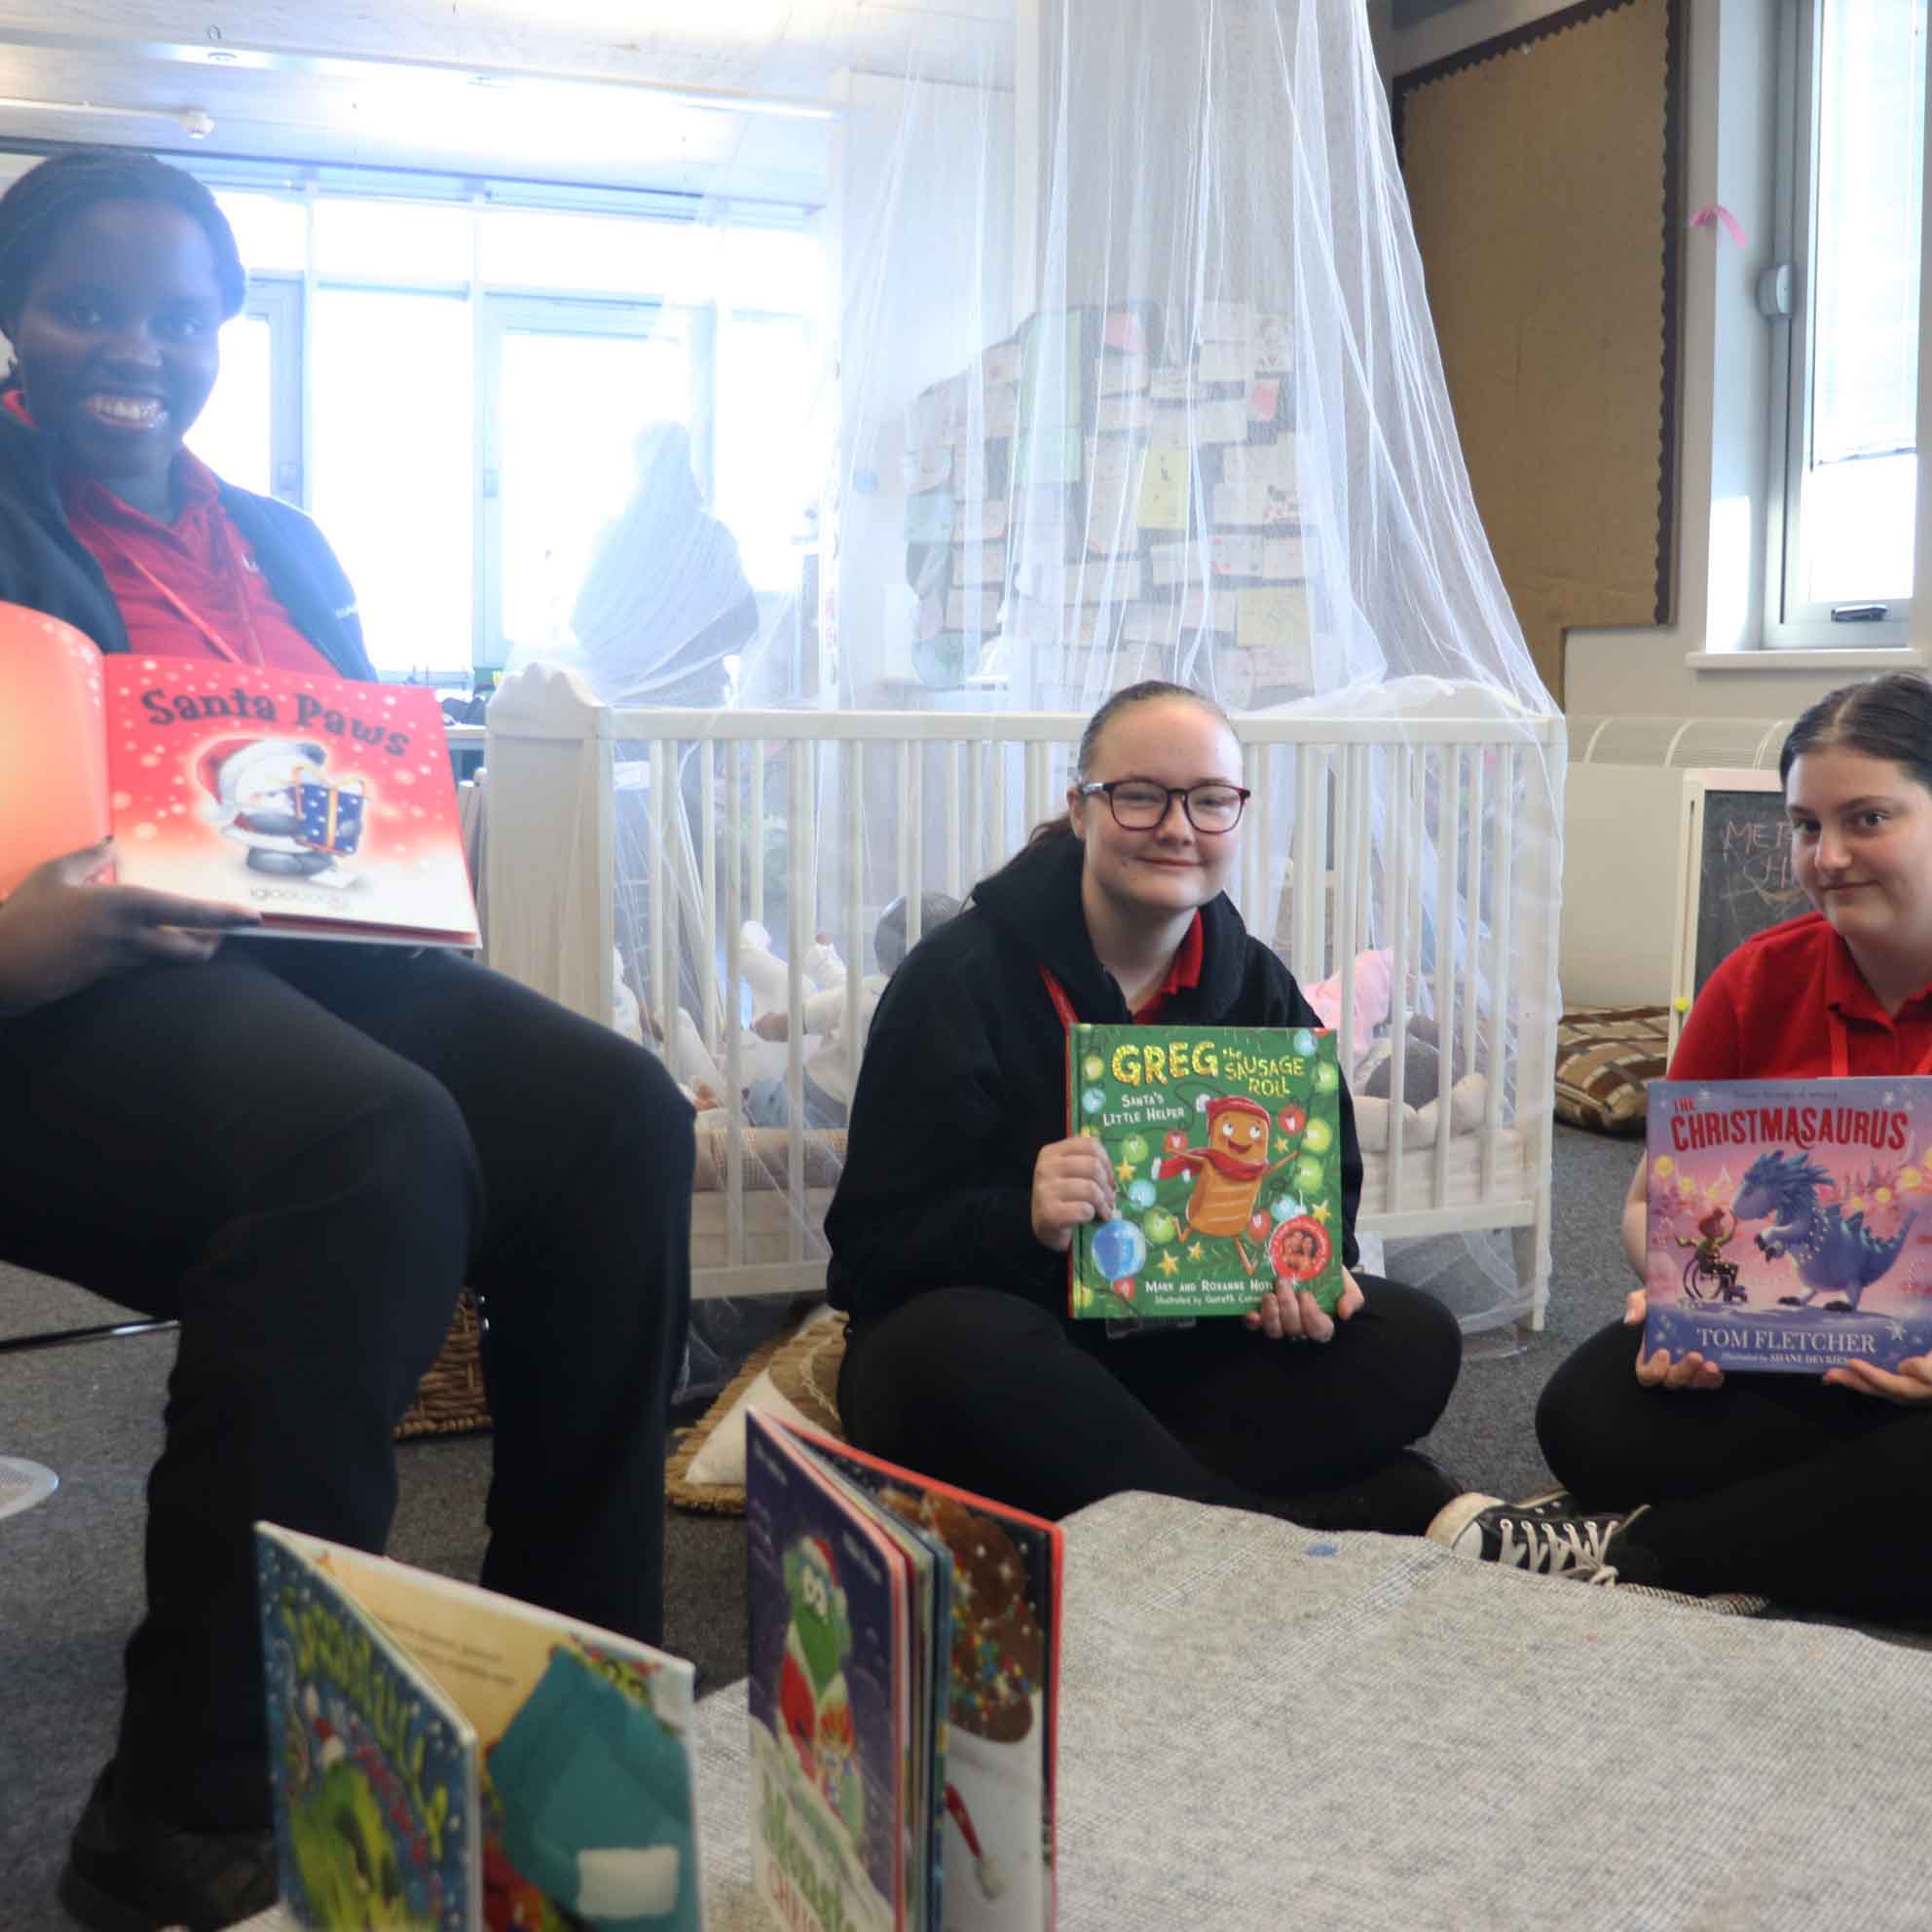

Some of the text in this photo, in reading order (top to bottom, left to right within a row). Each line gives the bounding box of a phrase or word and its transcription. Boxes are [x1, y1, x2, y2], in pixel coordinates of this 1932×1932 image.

[141, 687, 410, 757] Santa Paws
[1112, 1040, 1219, 1089] GREG
[1224, 1055, 1305, 1081] SAUSAGE
[1248, 1076, 1290, 1097] ROLL
[1103, 1107, 1185, 1127] LITTLE HELPER
[1672, 1096, 1695, 1113] THE
[1670, 1106, 1909, 1151] CHRISTMASAURUS
[1696, 1327, 1876, 1355] TOM FLETCHER
